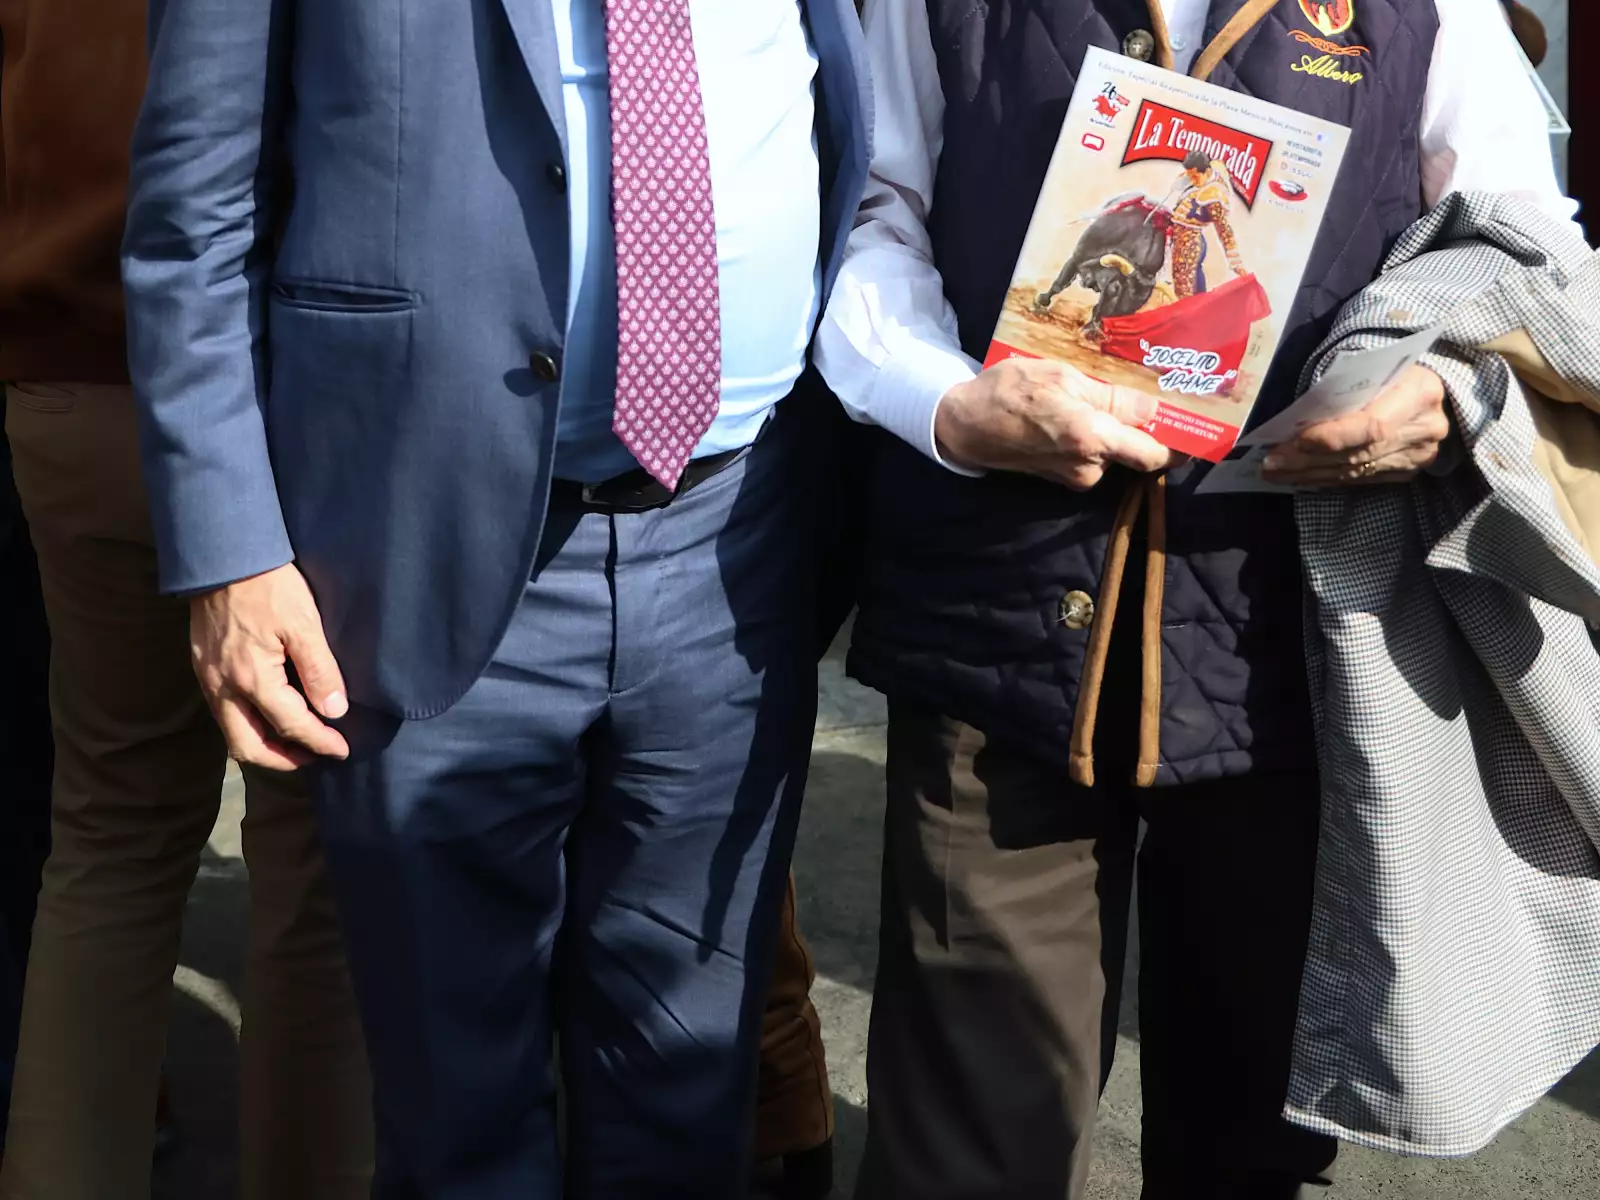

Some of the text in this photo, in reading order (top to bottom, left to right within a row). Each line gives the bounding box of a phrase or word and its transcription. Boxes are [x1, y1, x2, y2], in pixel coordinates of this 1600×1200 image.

[1290, 54, 1363, 84] Albero
[1134, 108, 1163, 150] La
[1166, 116, 1257, 190] Temporada
[1173, 420, 1218, 440] REAPERTURA
